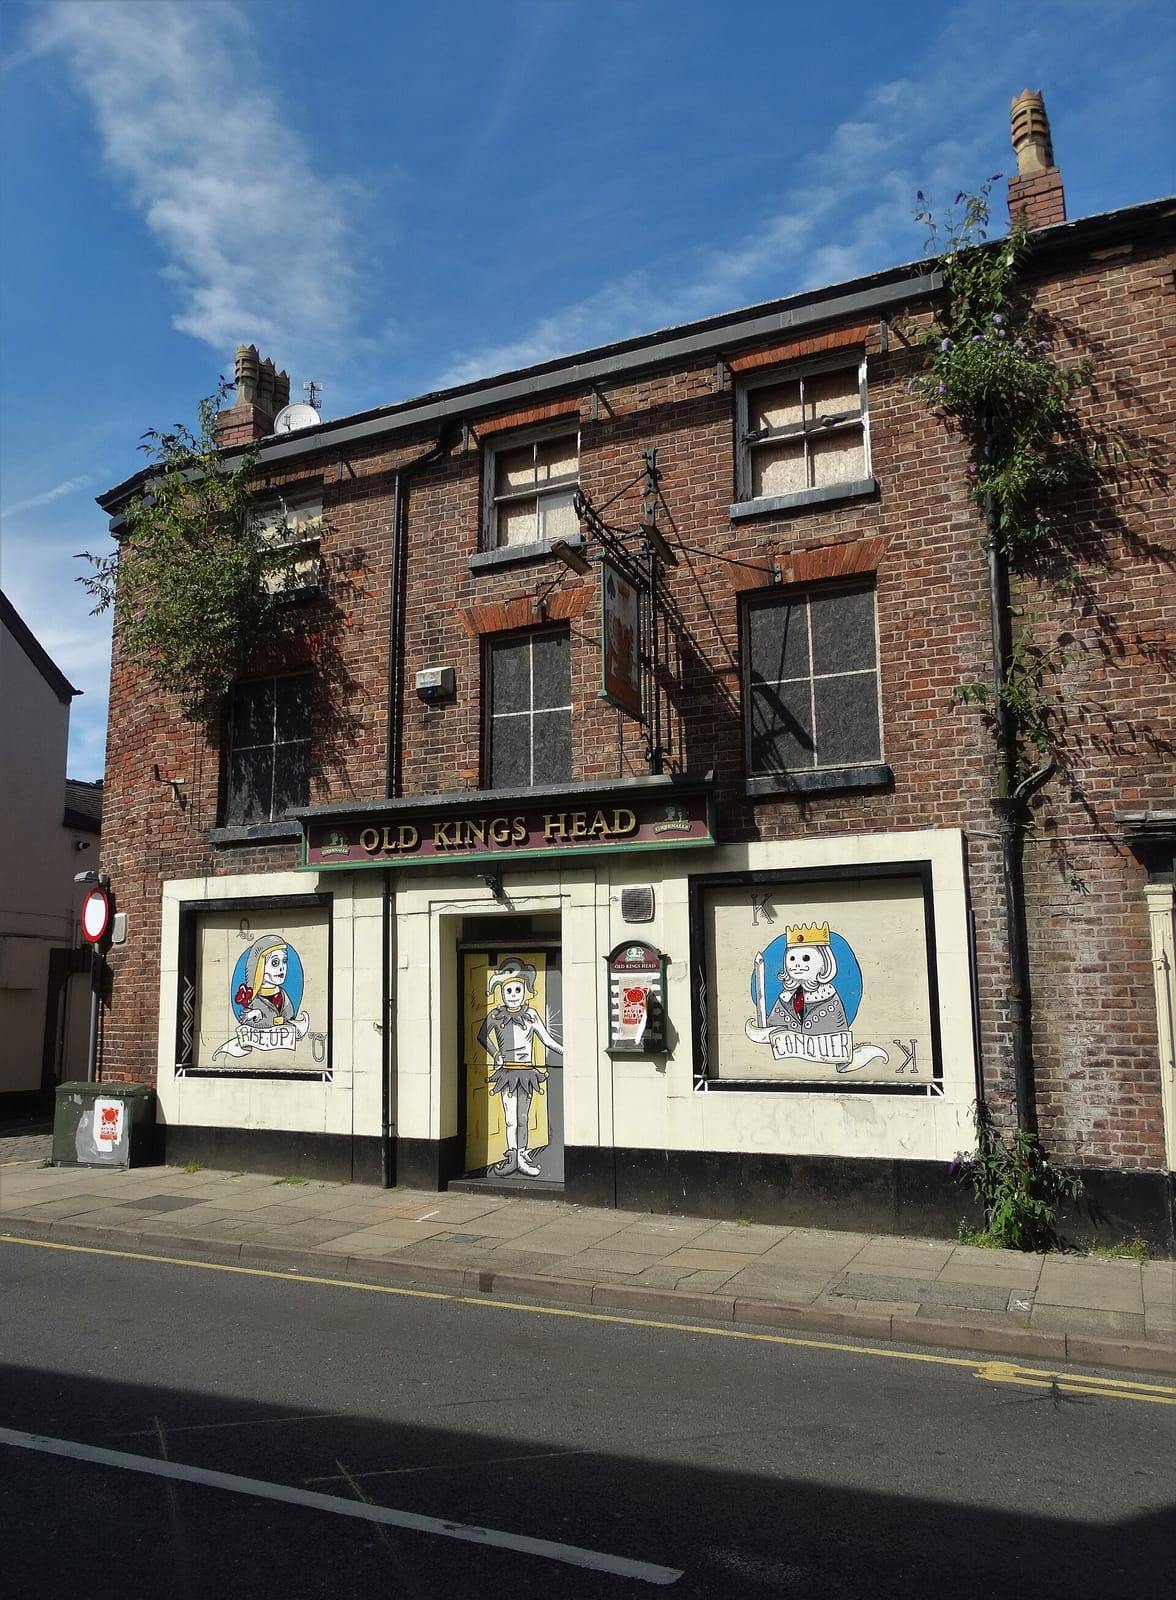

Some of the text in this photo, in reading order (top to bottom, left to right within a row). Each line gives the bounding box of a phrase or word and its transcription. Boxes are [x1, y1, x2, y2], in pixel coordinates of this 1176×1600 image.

[359, 807, 637, 851] OLD KINGS HEAD
[750, 893, 775, 926] K
[240, 1026, 290, 1047] RISE UP
[774, 1033, 849, 1058] CONQUER
